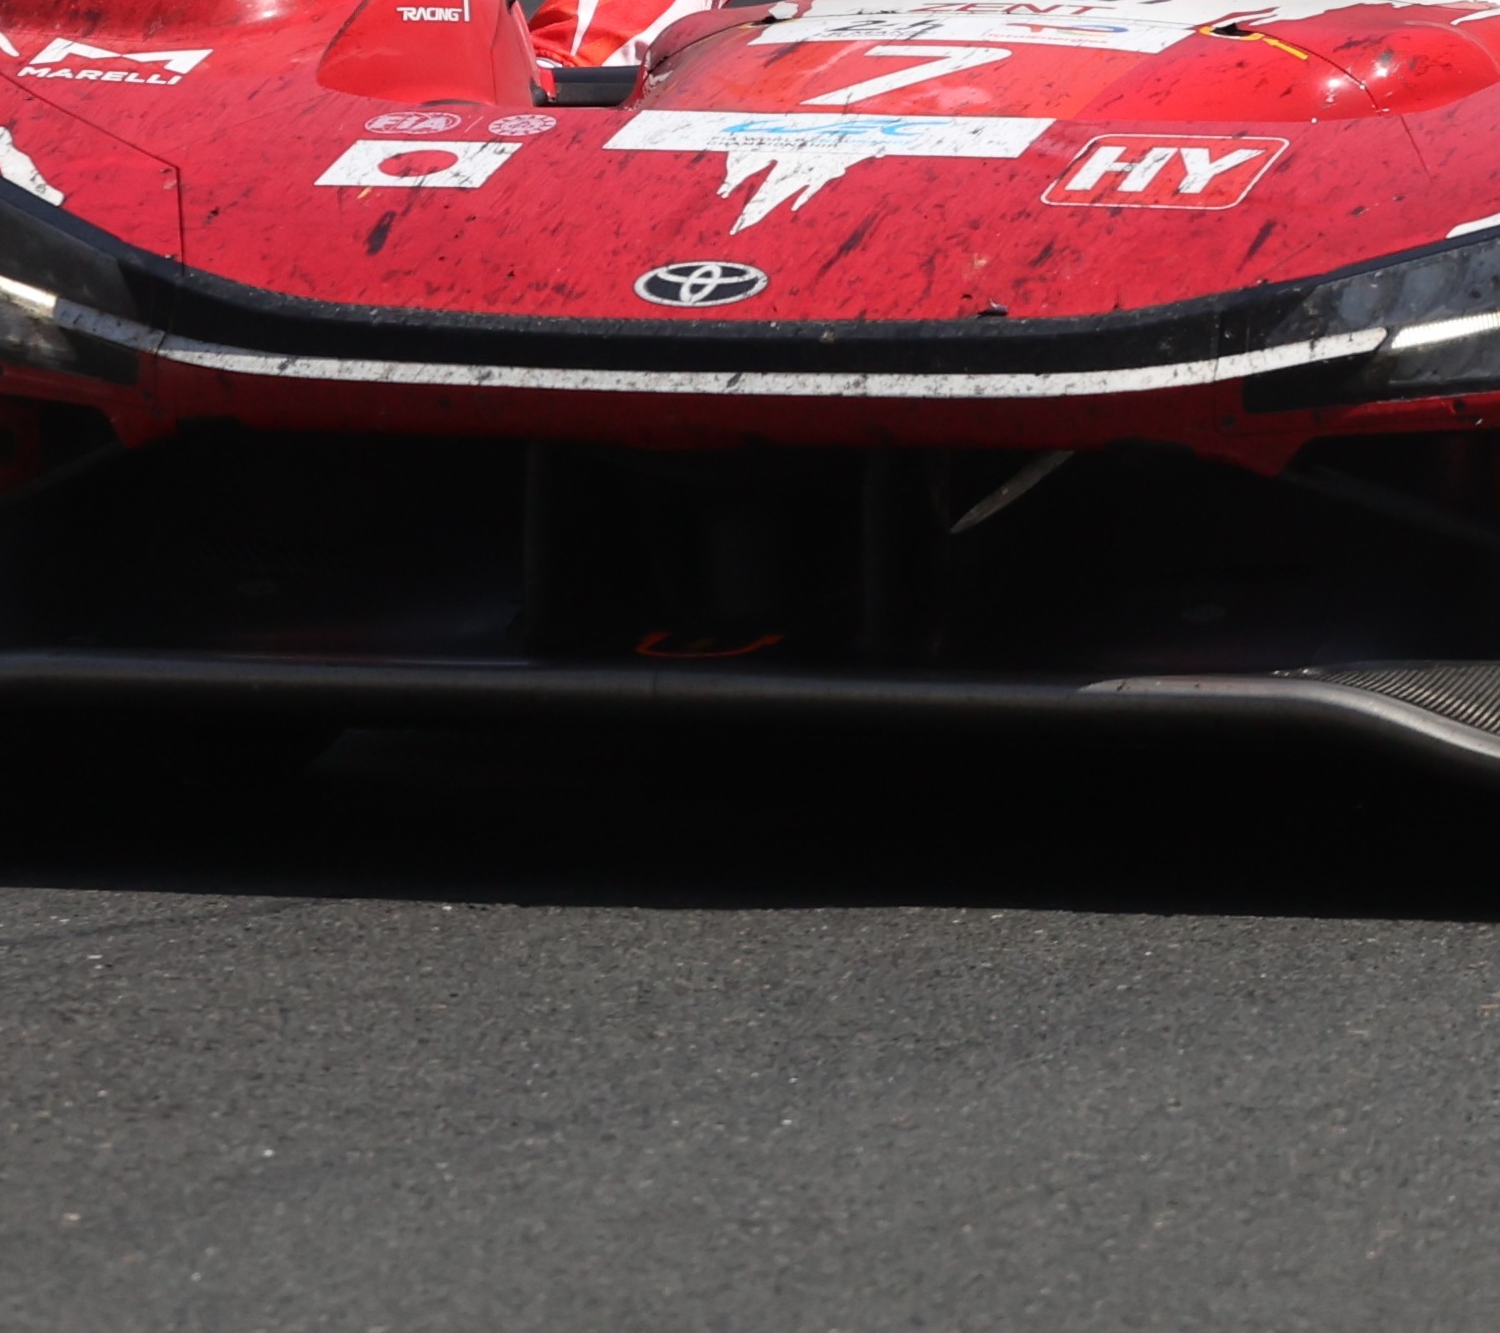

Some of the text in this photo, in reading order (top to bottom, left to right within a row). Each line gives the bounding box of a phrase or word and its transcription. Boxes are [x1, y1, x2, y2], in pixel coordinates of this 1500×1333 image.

[396, 6, 463, 22] RACING
[907, 3, 1116, 15] ZENT
[17, 65, 183, 86] MARELLI
[799, 45, 1014, 107] 7
[1064, 144, 1265, 194] HY
